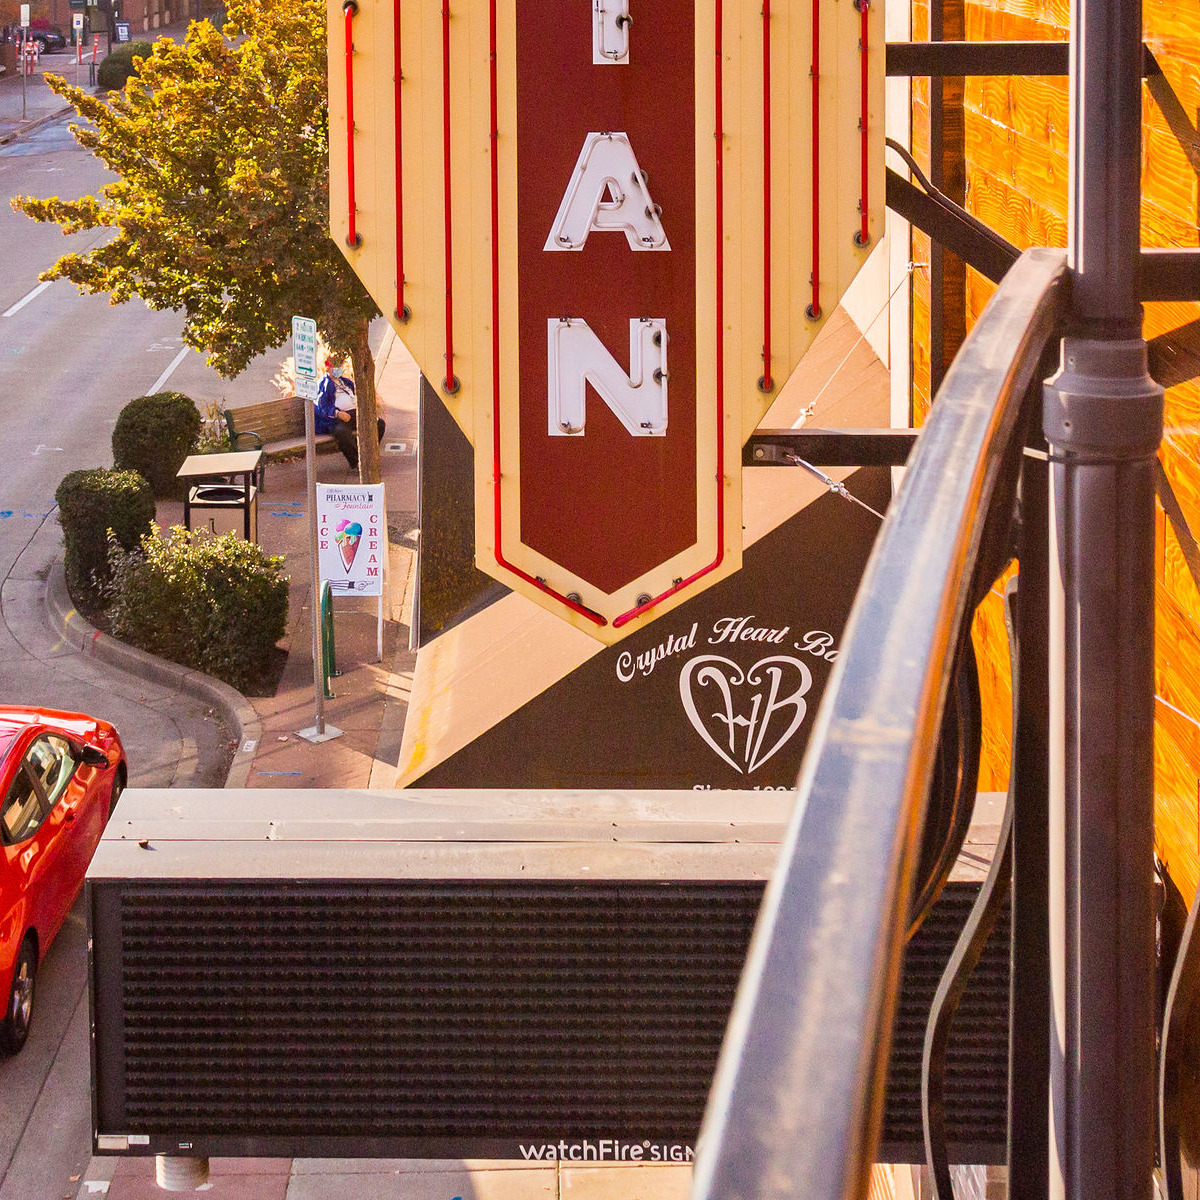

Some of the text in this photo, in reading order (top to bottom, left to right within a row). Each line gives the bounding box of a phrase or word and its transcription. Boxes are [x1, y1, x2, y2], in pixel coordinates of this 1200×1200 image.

[320, 515, 329, 550] ICE
[367, 515, 379, 576] CREAM
[616, 622, 699, 683] Crystal
[708, 615, 791, 644] Heart
